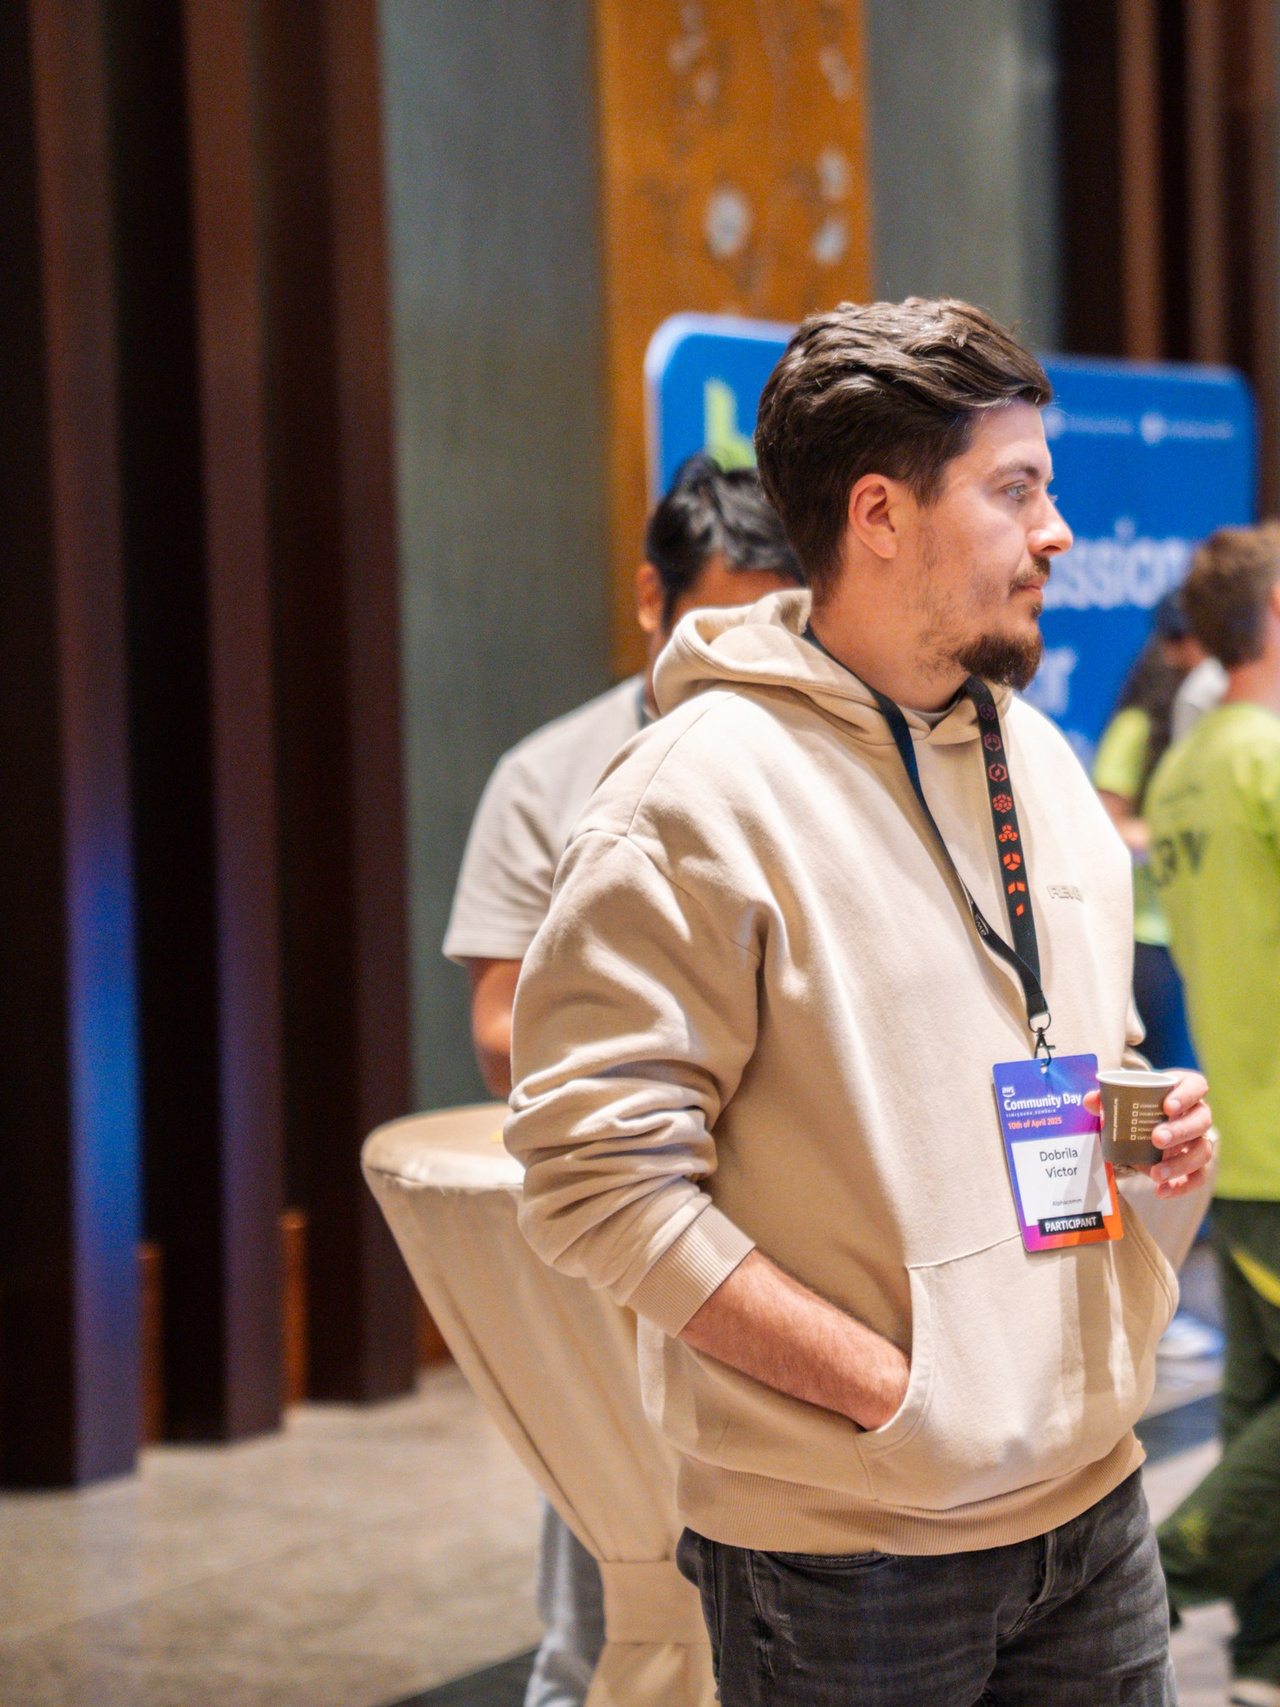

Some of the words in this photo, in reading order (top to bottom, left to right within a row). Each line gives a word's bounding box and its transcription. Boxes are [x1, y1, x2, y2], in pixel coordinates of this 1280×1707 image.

[1004, 1095, 1061, 1112] Community
[1062, 1093, 1082, 1107] Day
[1008, 1120, 1022, 1130] 10th
[1023, 1120, 1031, 1129] of
[1031, 1118, 1047, 1129] April
[1047, 1116, 1062, 1126] 2025
[1039, 1147, 1078, 1162] Dobrila
[1045, 1166, 1078, 1178] Victor
[1044, 1216, 1097, 1233] PARTICIPANT
